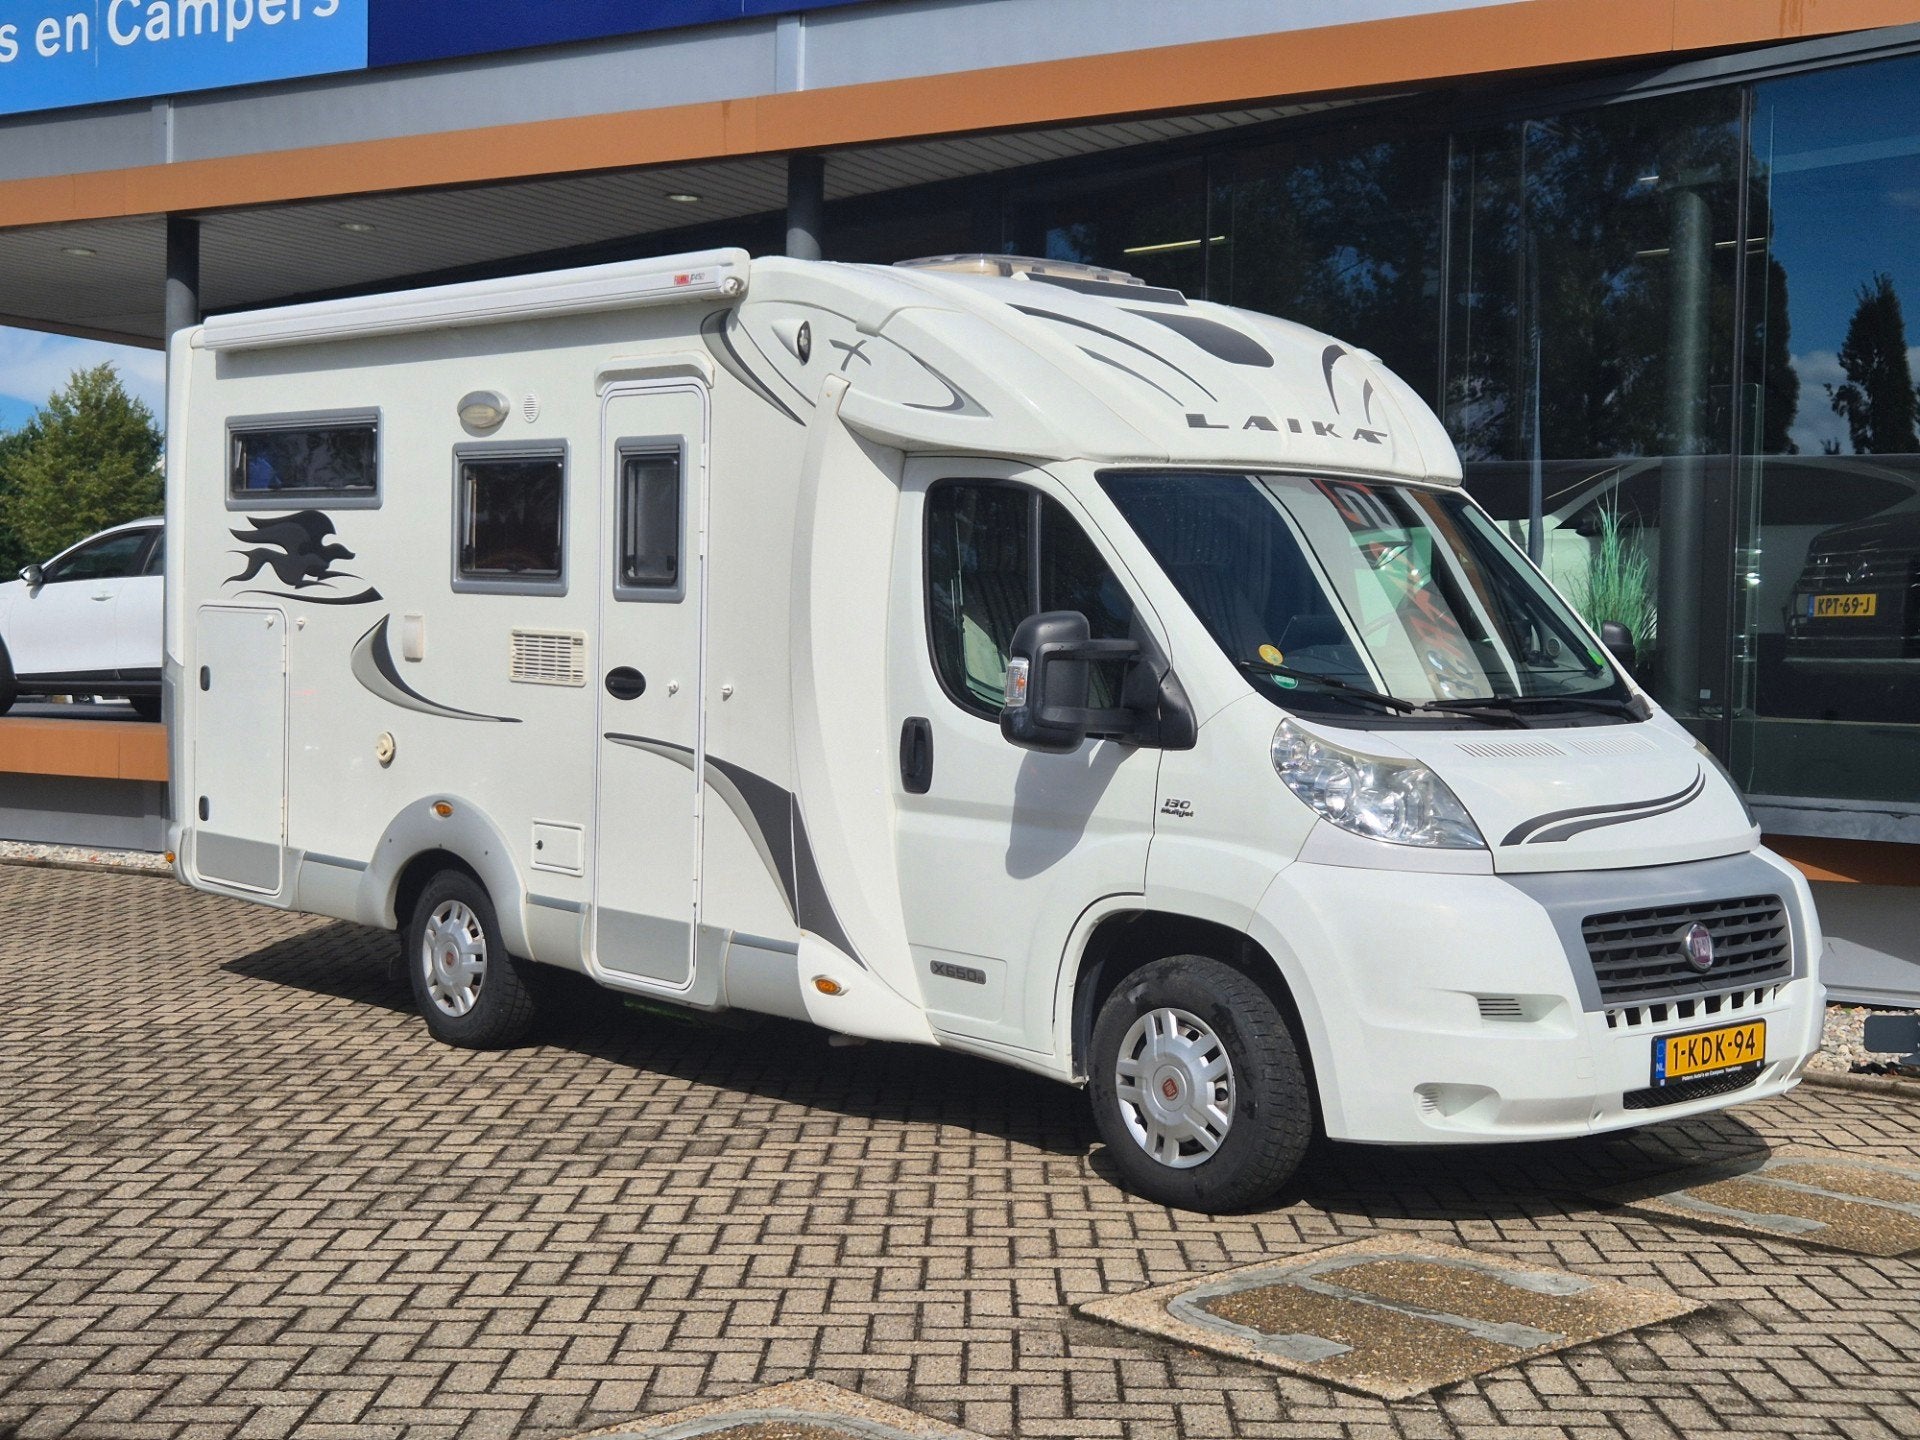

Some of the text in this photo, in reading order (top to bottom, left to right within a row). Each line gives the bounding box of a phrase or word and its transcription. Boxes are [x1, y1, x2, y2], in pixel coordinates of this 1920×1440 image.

[35, 12, 89, 57] en
[1185, 413, 1388, 445] LAIKA
[1817, 596, 1871, 615] KPT-69-J
[1164, 798, 1191, 809] 130
[1672, 1027, 1756, 1071] 1-KDK-94
